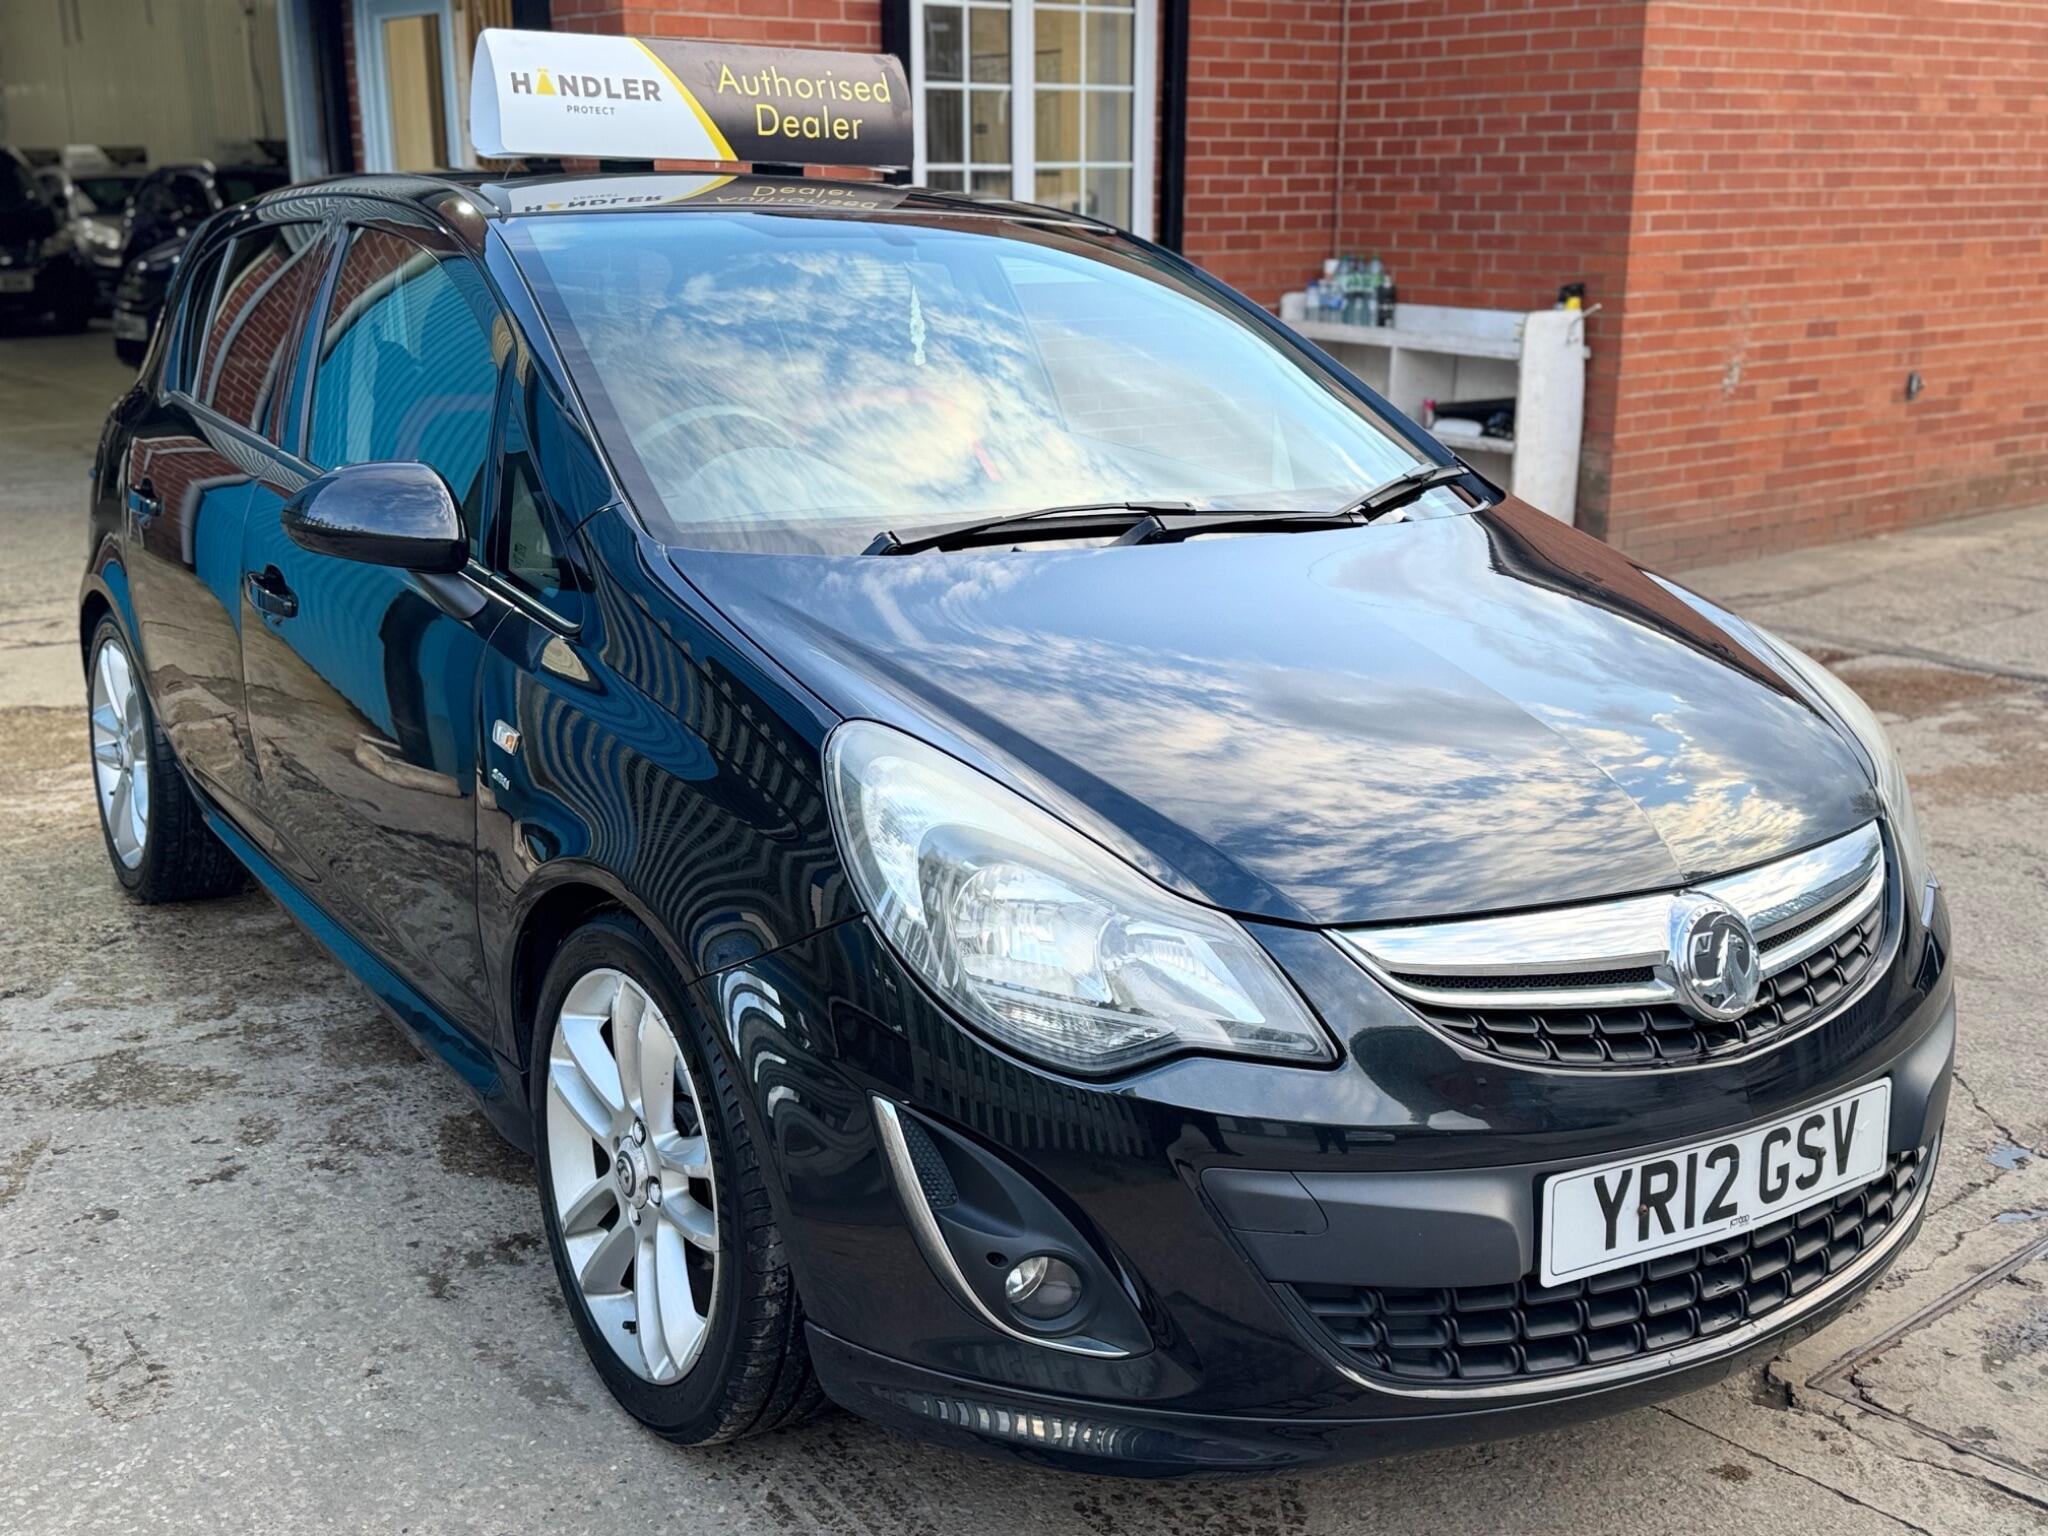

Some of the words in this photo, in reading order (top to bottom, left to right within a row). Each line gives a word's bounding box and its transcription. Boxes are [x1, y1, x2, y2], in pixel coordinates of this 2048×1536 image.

[717, 63, 892, 103] Authorised
[566, 104, 616, 116] PROTECT
[755, 103, 864, 140] Dealer
[1593, 1143, 1740, 1251] YR12
[1757, 1099, 1860, 1205] GSV
